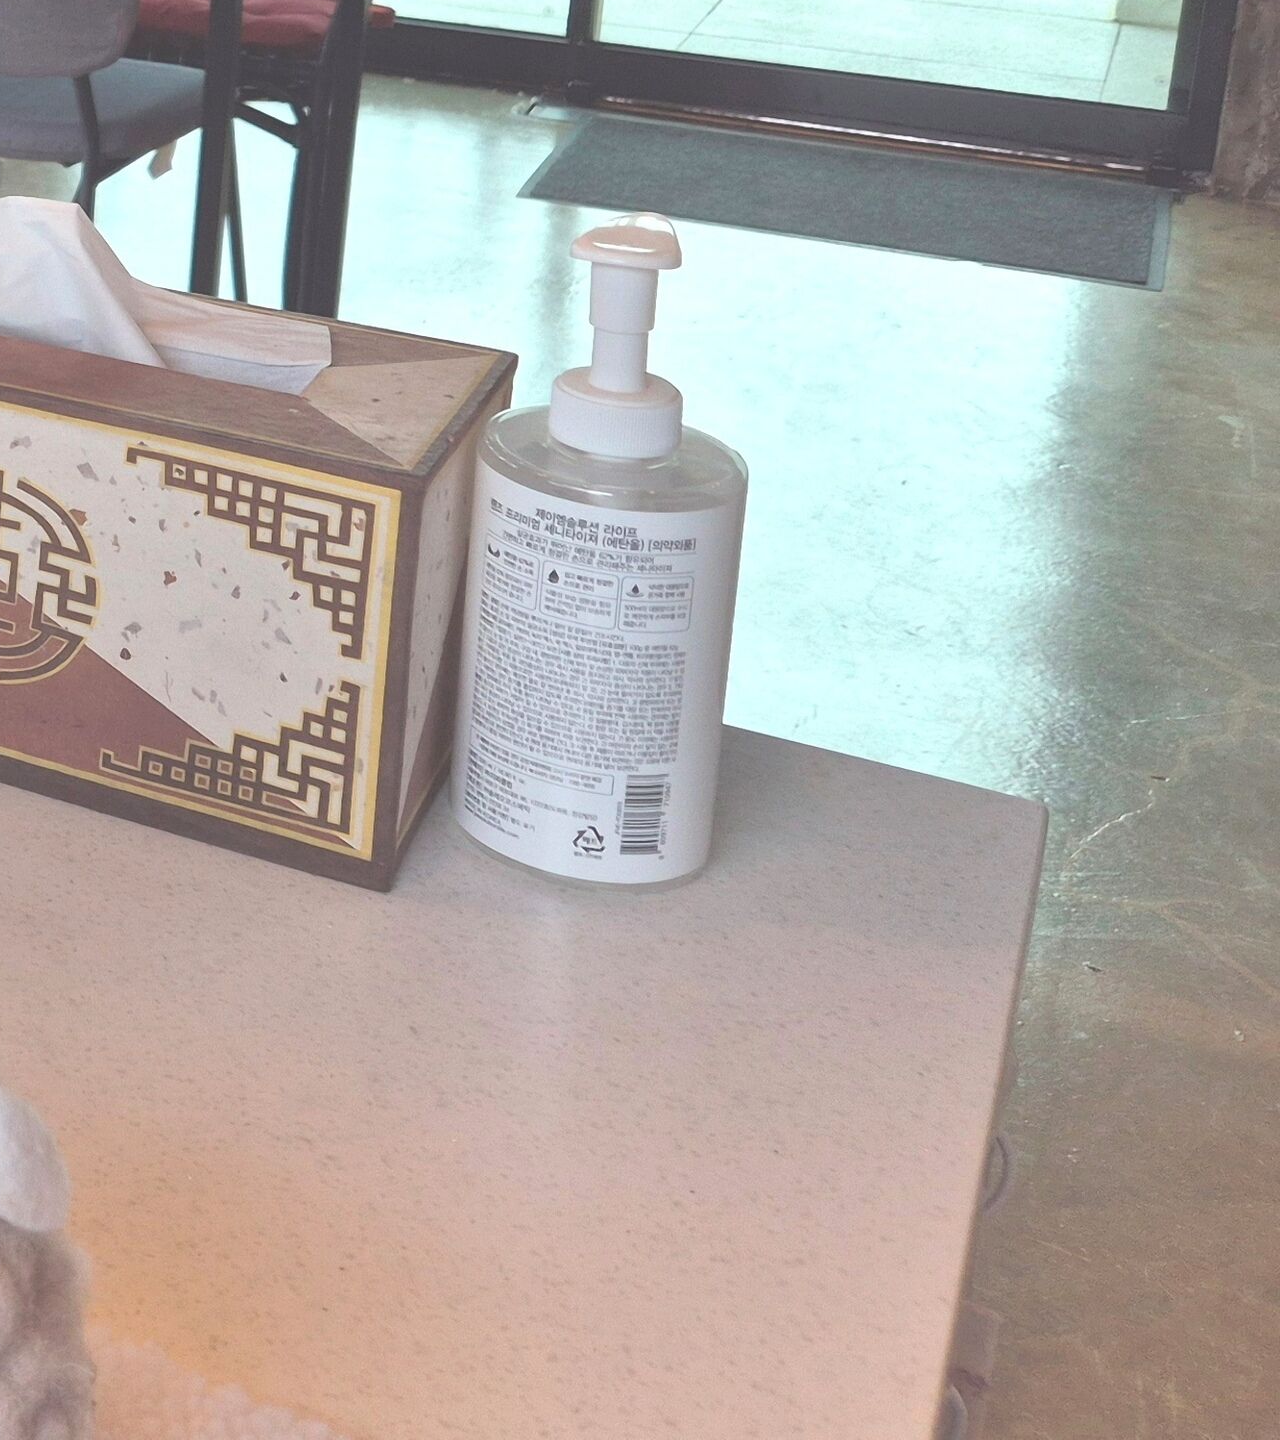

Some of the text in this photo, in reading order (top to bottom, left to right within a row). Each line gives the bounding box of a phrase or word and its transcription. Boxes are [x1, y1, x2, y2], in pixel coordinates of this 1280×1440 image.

[505, 507, 541, 531] 프리미엄
[602, 536, 645, 551] (에탄올)
[647, 537, 697, 552] [의약외품]
[535, 508, 638, 539] 제이엠솔루션 라이프
